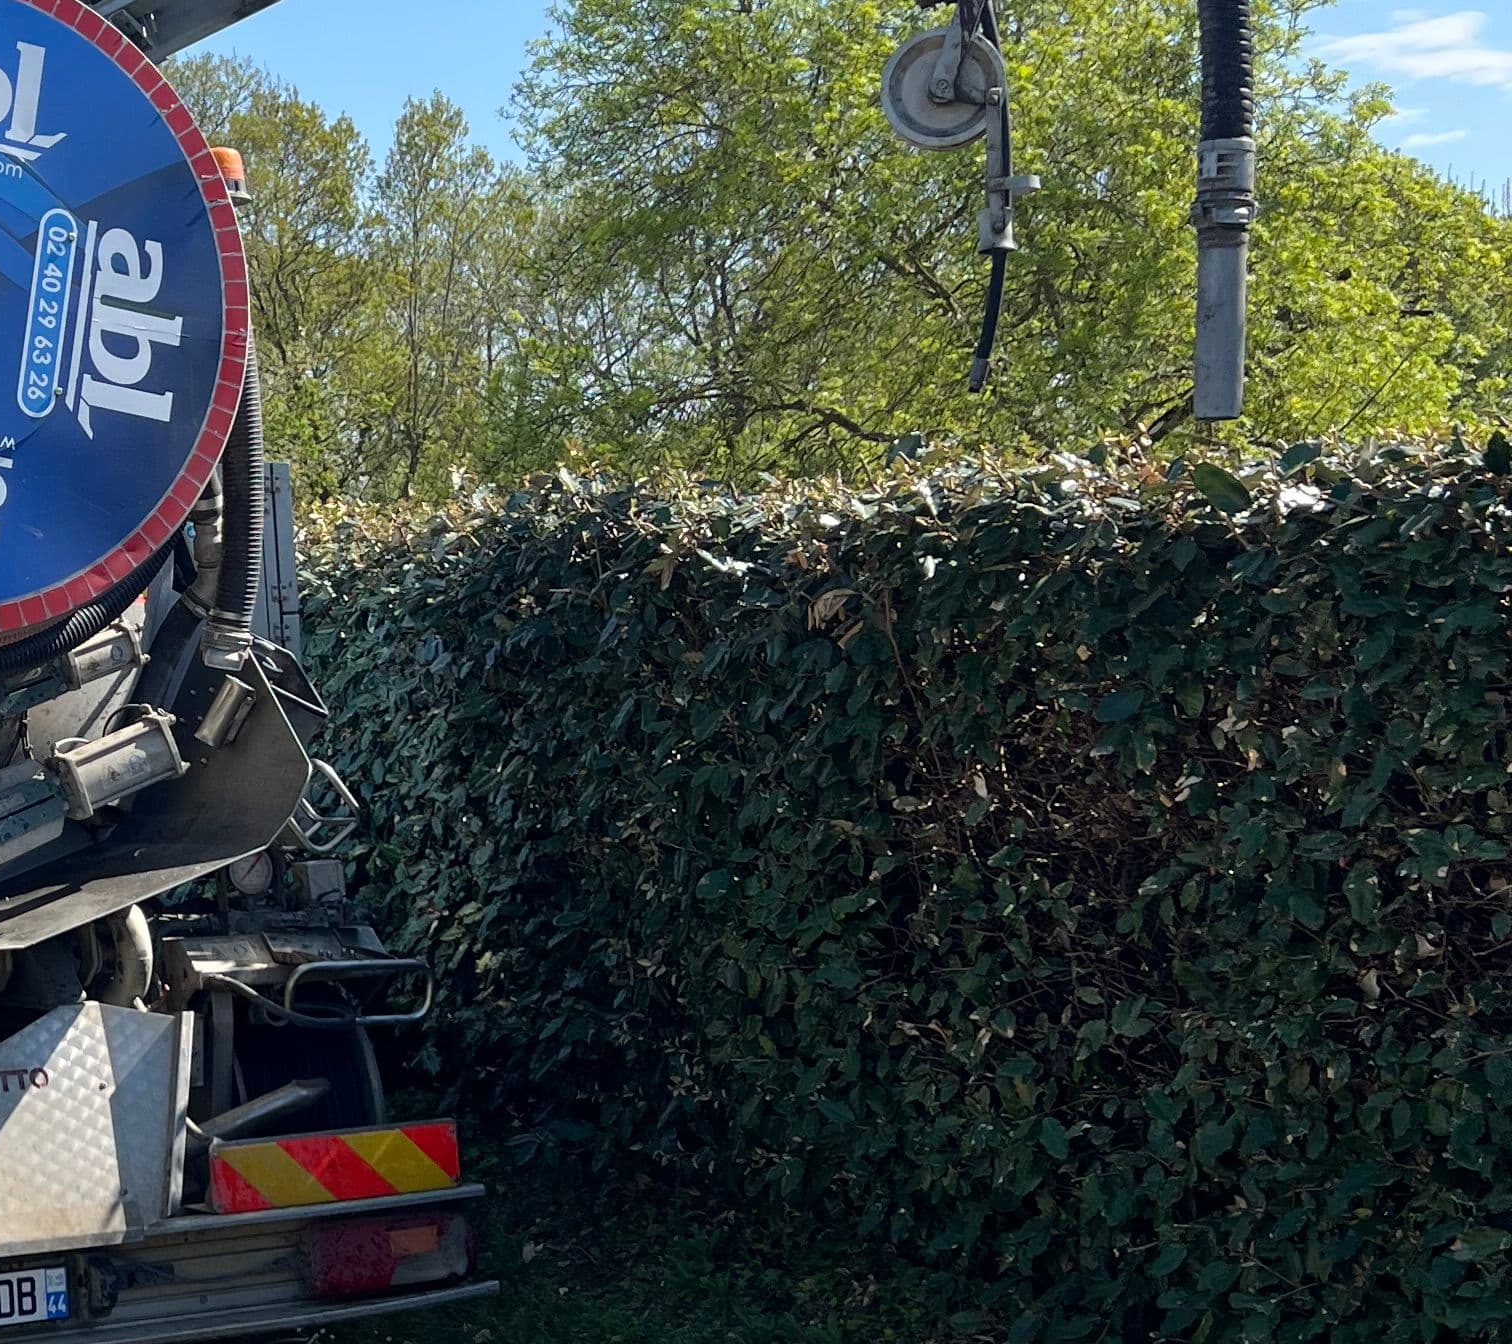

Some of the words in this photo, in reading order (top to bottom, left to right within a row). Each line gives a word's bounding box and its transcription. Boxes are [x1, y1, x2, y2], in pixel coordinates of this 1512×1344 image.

[45, 226, 68, 257] 02
[41, 263, 63, 293] 40
[37, 298, 58, 329] 29
[77, 226, 184, 439] abl
[32, 335, 53, 365] 63
[26, 370, 49, 400] 26
[47, 1292, 68, 1315] 44
